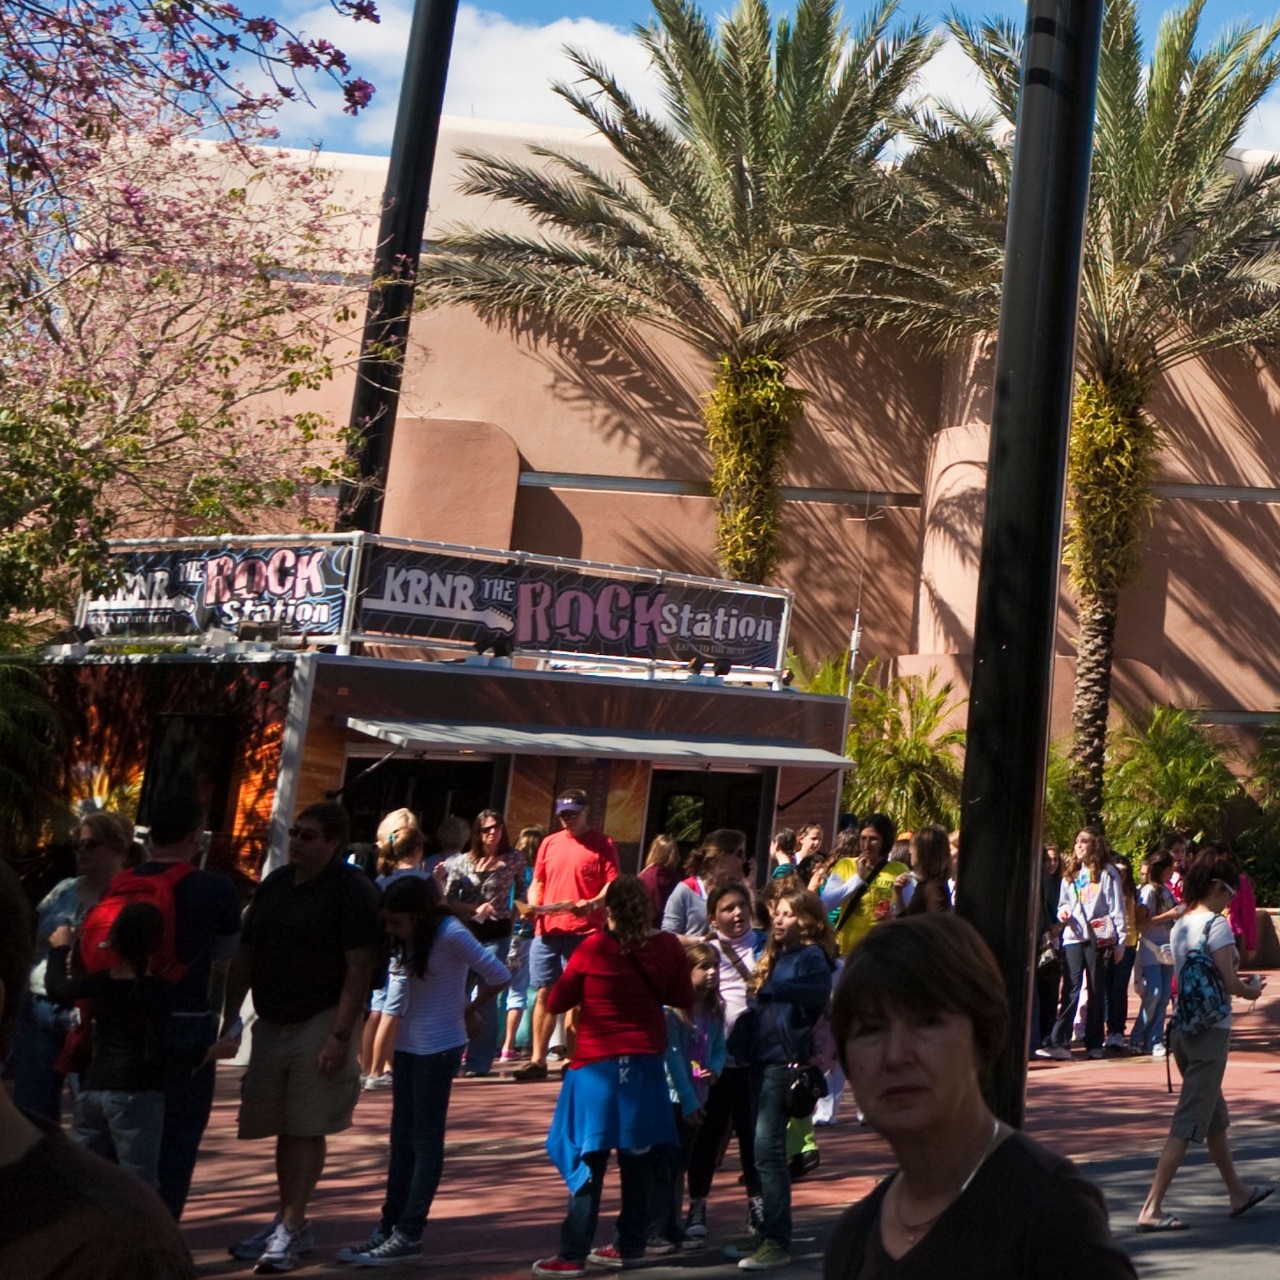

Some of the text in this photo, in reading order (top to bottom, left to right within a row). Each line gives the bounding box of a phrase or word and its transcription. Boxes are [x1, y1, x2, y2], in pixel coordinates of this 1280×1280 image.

[179, 560, 204, 583] THE
[205, 549, 325, 605] ROCK
[222, 599, 331, 625] Station
[383, 565, 774, 648] KRNR THE ROCK Station
